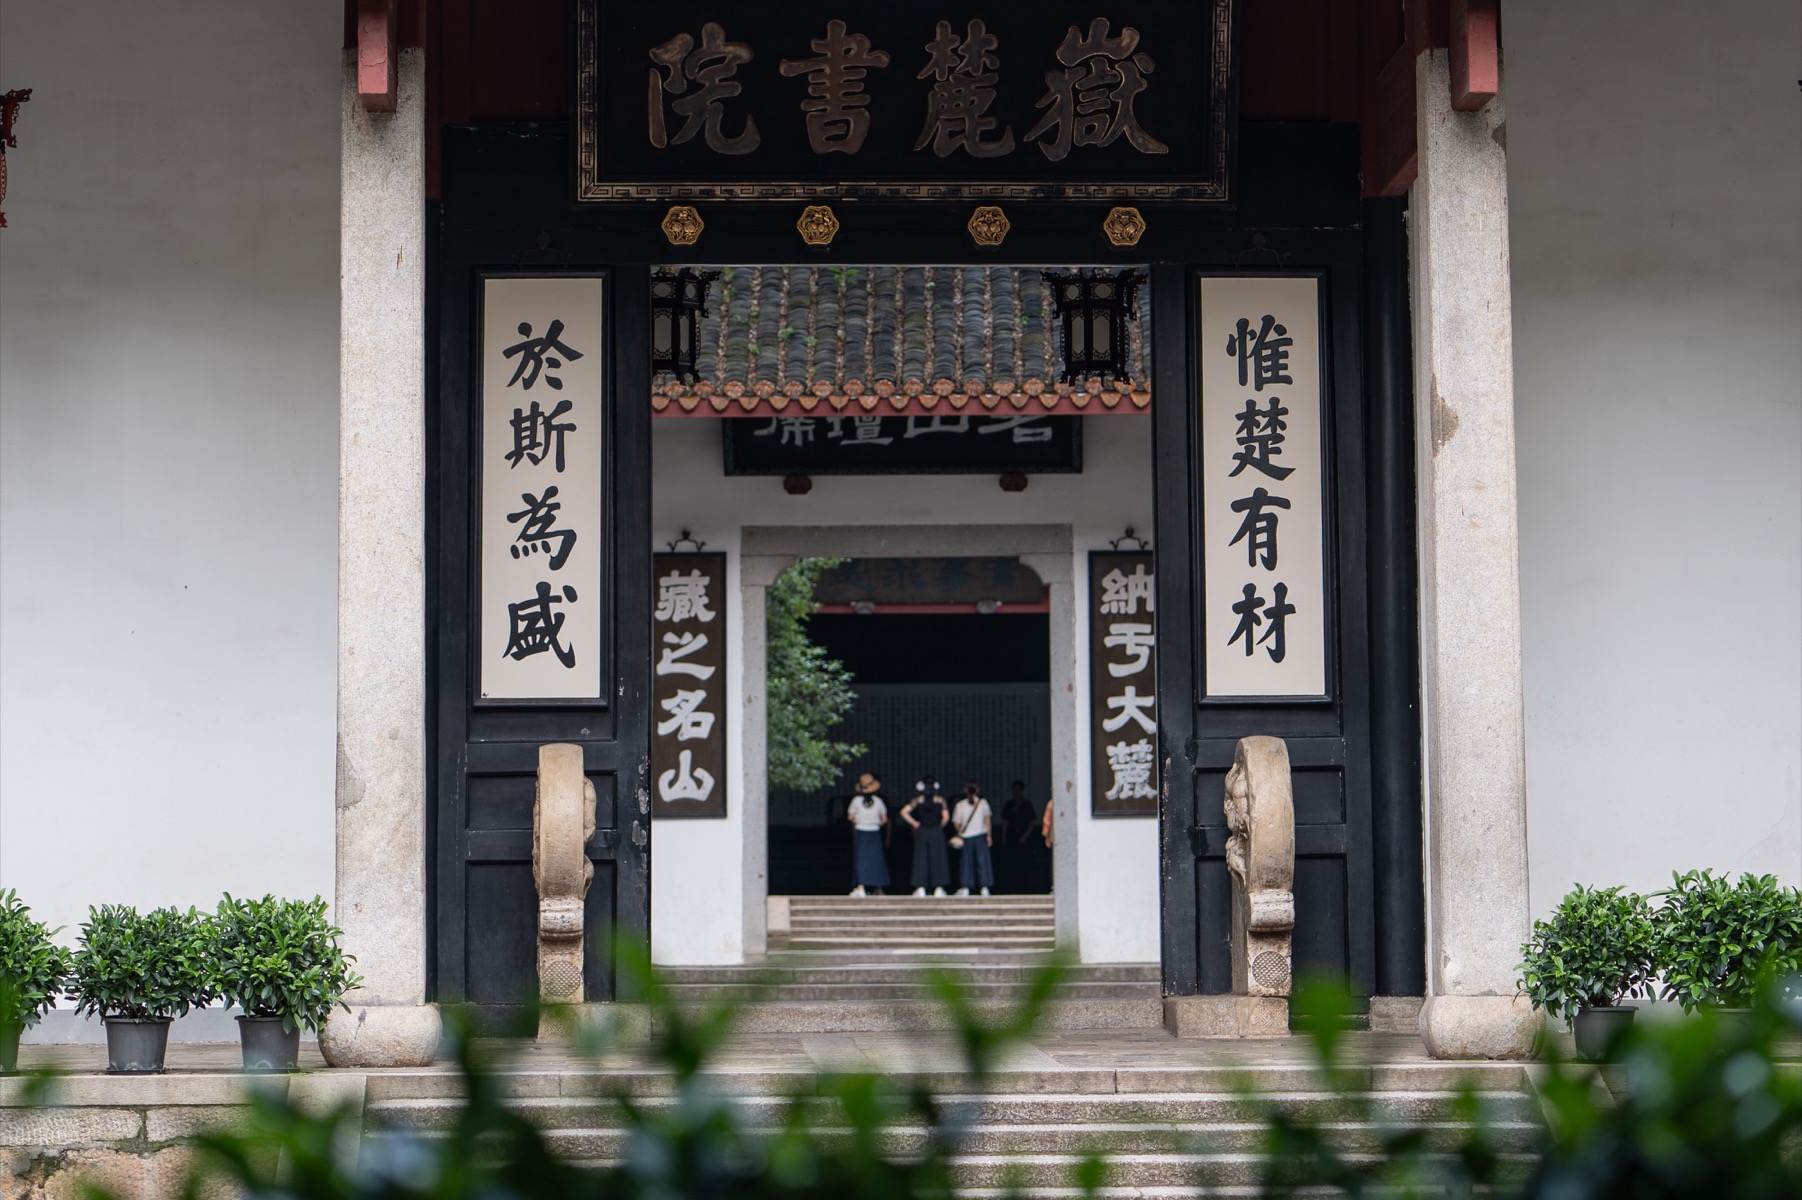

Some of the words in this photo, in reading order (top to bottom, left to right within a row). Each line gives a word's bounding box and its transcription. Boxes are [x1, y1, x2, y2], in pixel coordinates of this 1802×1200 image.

[648, 16, 1169, 162] 嶽麓書院
[501, 318, 585, 669] 於斯為盛
[1225, 313, 1297, 664] 惟楚有材
[654, 569, 716, 803] 藏之名山
